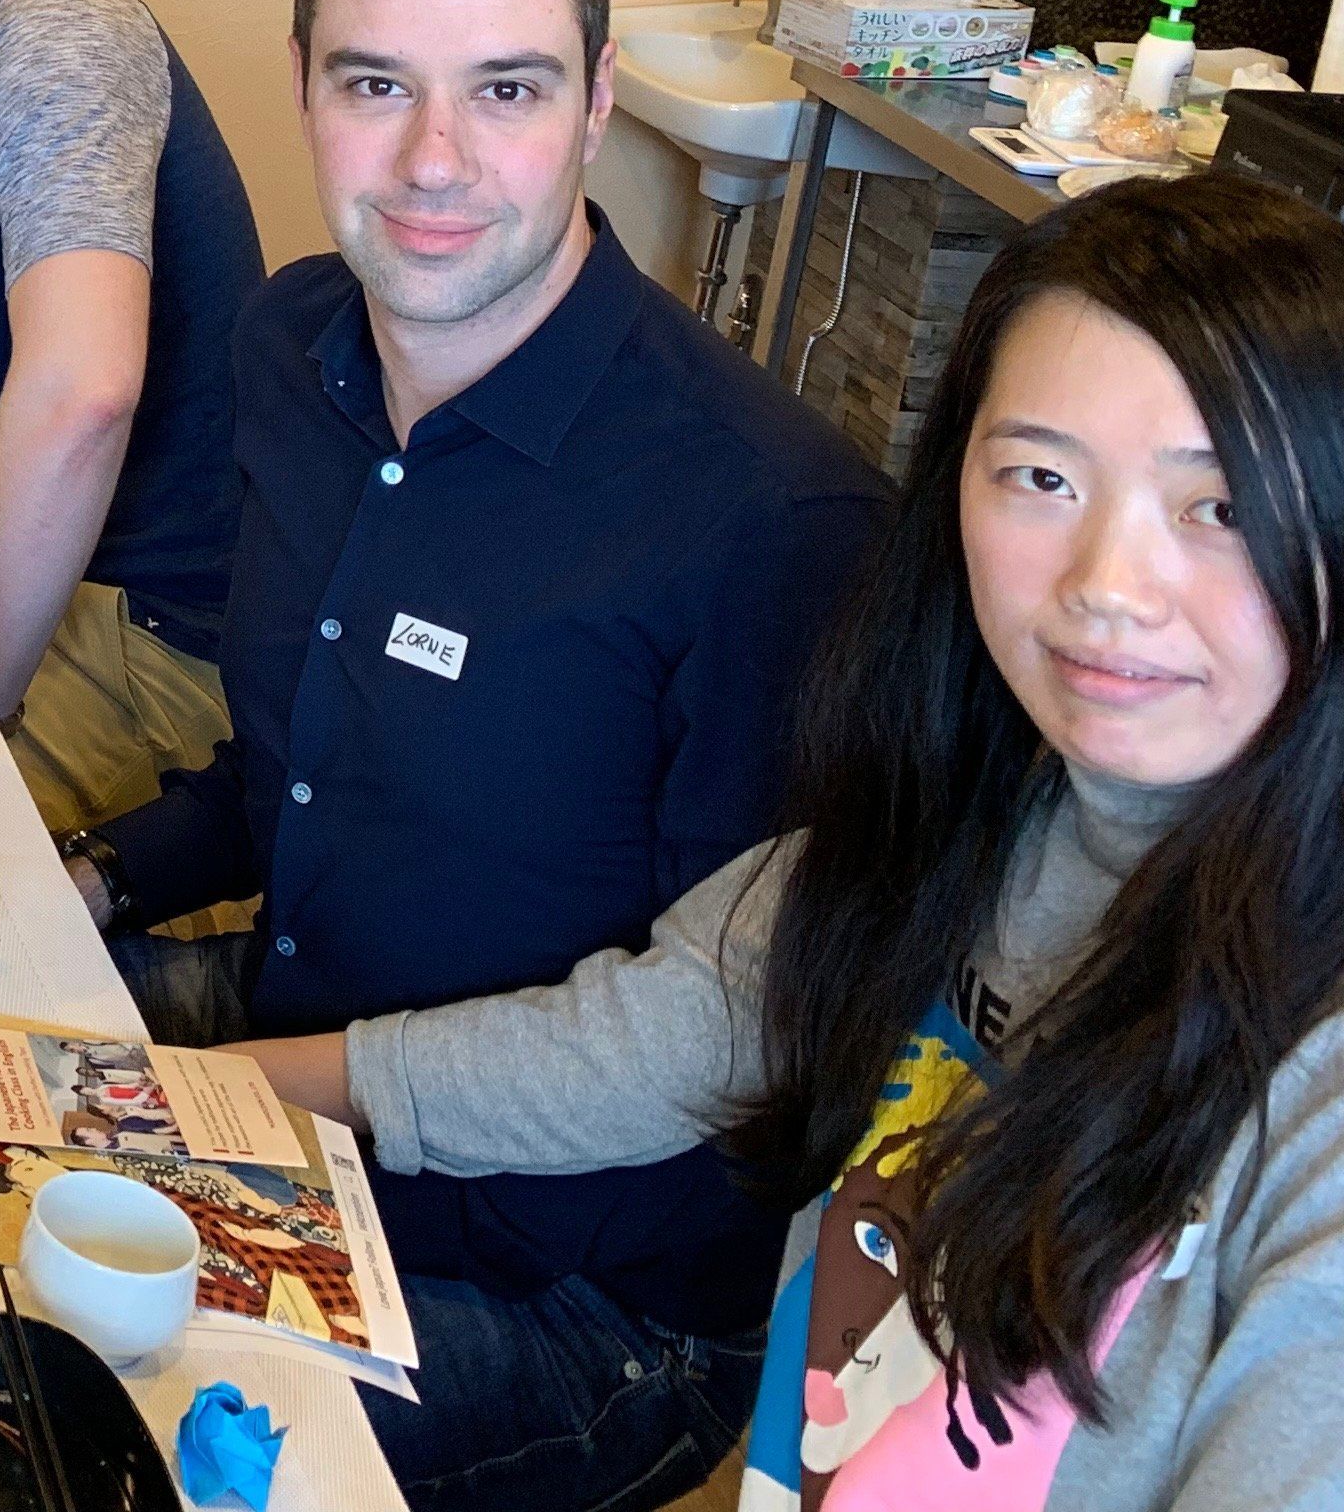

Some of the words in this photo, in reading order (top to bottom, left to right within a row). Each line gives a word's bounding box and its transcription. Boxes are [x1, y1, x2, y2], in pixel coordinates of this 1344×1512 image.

[861, 11, 906, 26] うれしい
[858, 29, 904, 42] キッチン
[852, 45, 889, 59] タオル
[390, 622, 456, 667] LORNE
[9, 1076, 23, 1097] Class
[17, 1096, 34, 1131] Cooking
[6, 1115, 20, 1131] The
